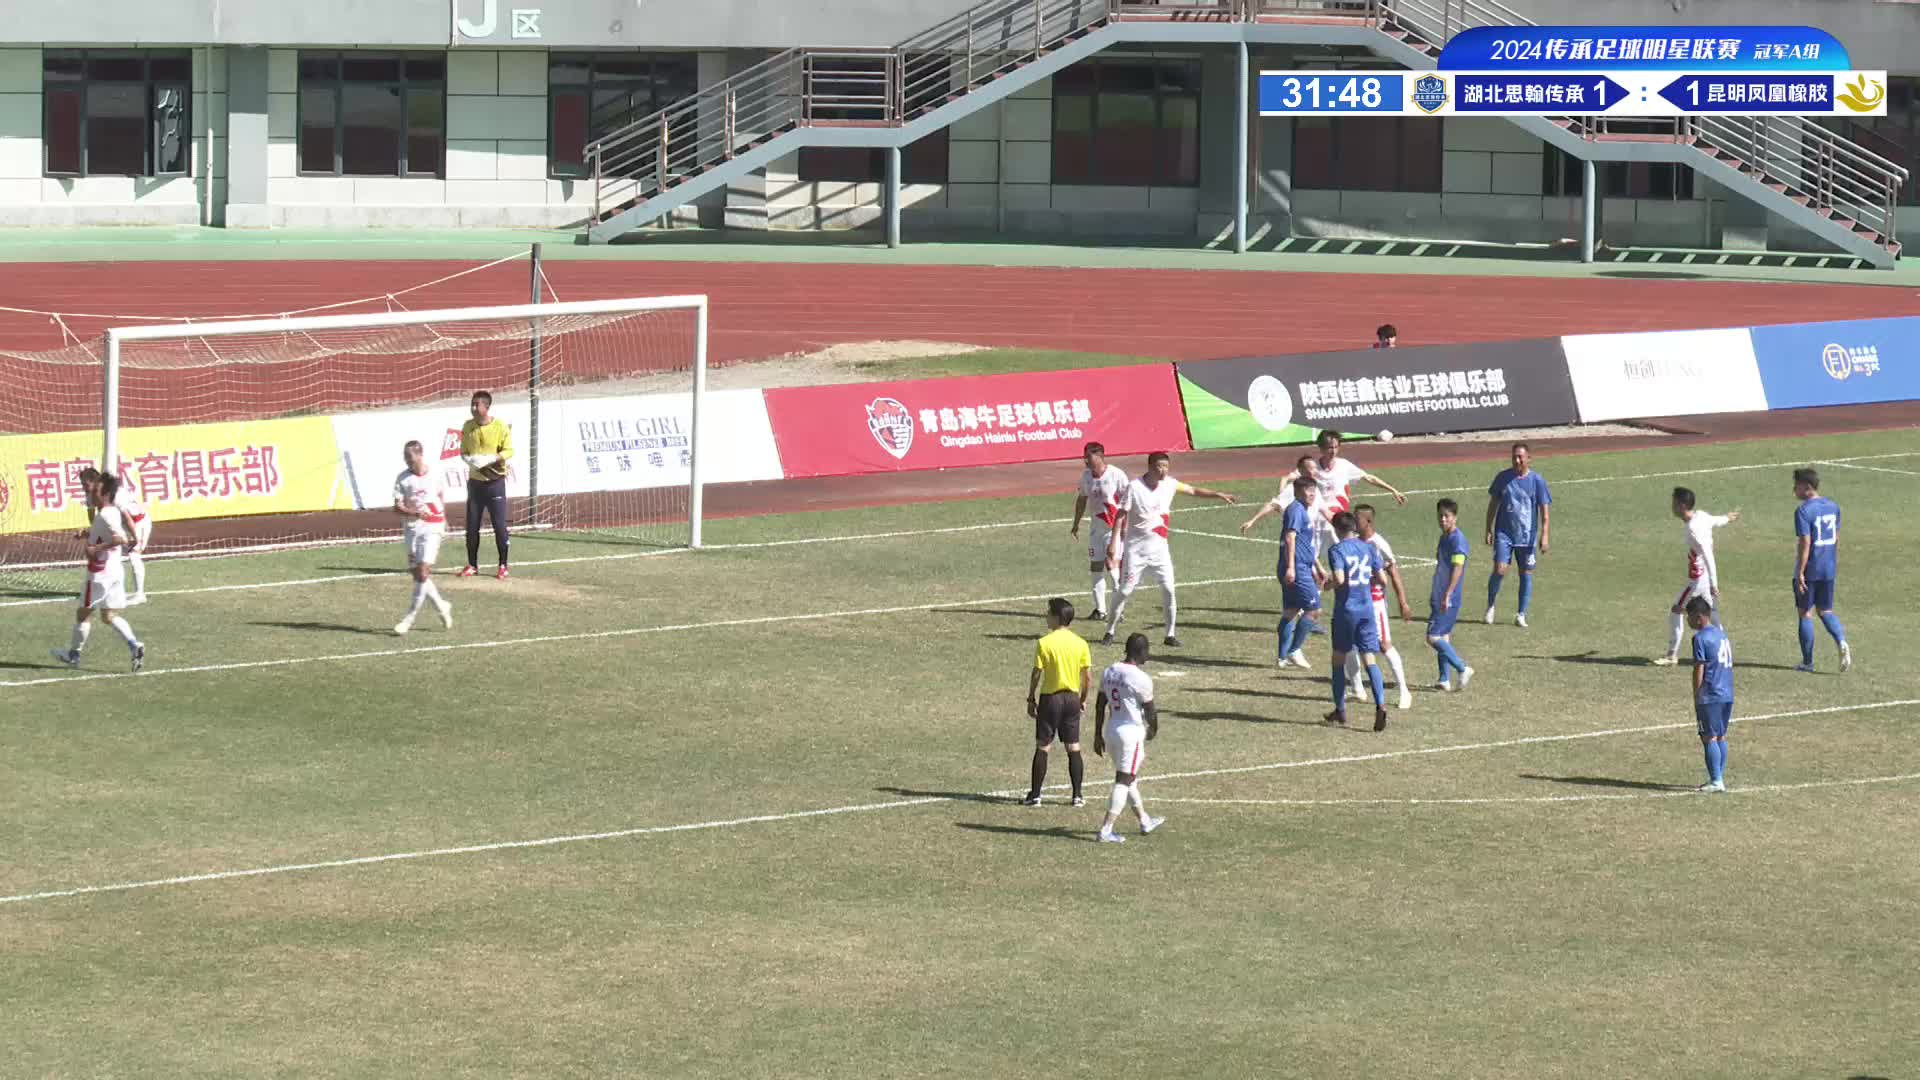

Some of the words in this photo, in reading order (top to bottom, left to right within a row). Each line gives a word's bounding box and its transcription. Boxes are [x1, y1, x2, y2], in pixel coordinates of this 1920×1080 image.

[1299, 368, 1506, 406] 陕西佳鑫伟业足球俱乐部
[919, 399, 1091, 433] 青岛海牛足球俱乐部
[1305, 406, 1353, 420] SHAANXI
[1354, 404, 1389, 417] JIAXIN
[1390, 402, 1423, 415] WEIYE
[1424, 398, 1480, 412] FOOTBALL
[1481, 395, 1509, 408] CLUB
[577, 418, 630, 441] BLUE
[635, 415, 686, 437] GIRL
[940, 433, 983, 449] Qingdao
[985, 432, 1016, 445] Hainiu
[1018, 429, 1057, 442] Football
[1059, 426, 1083, 440] Club
[1814, 514, 1837, 546] 13
[1346, 553, 1372, 584] 26
